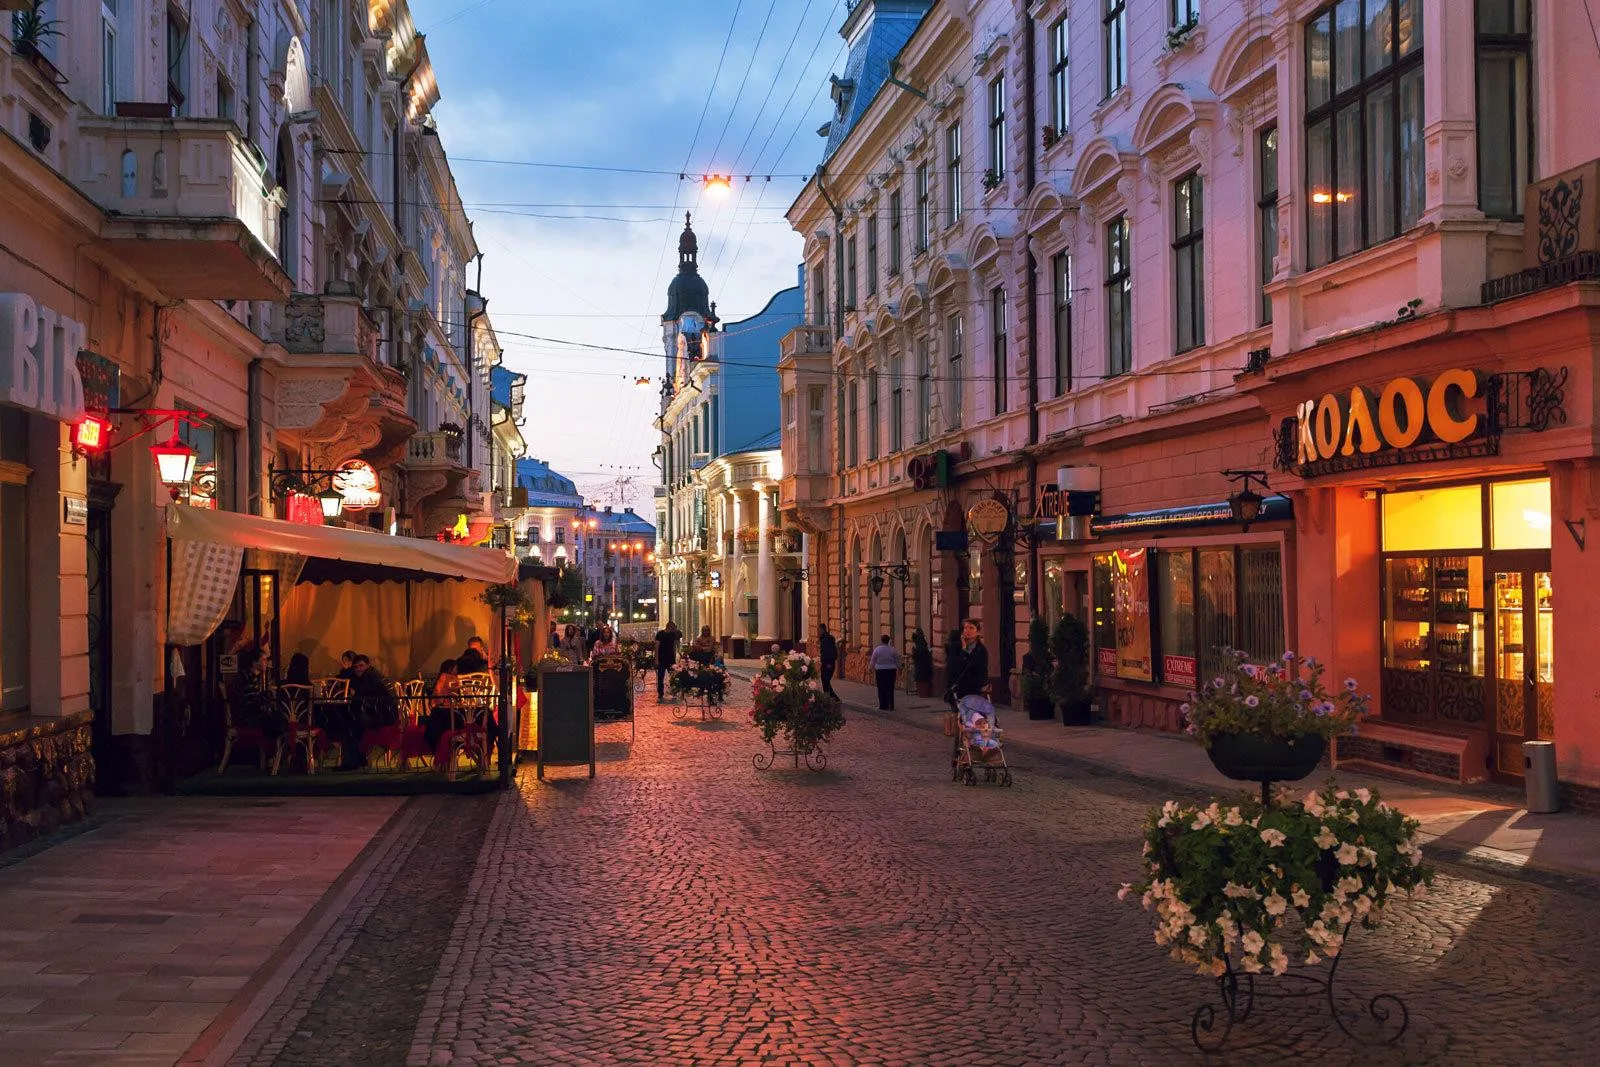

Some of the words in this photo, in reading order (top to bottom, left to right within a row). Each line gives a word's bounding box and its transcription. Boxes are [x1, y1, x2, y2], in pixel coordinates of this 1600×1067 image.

[1296, 368, 1479, 465] КОЛОС
[1034, 484, 1070, 517] XTREME
[1166, 659, 1193, 673] EXTREME
